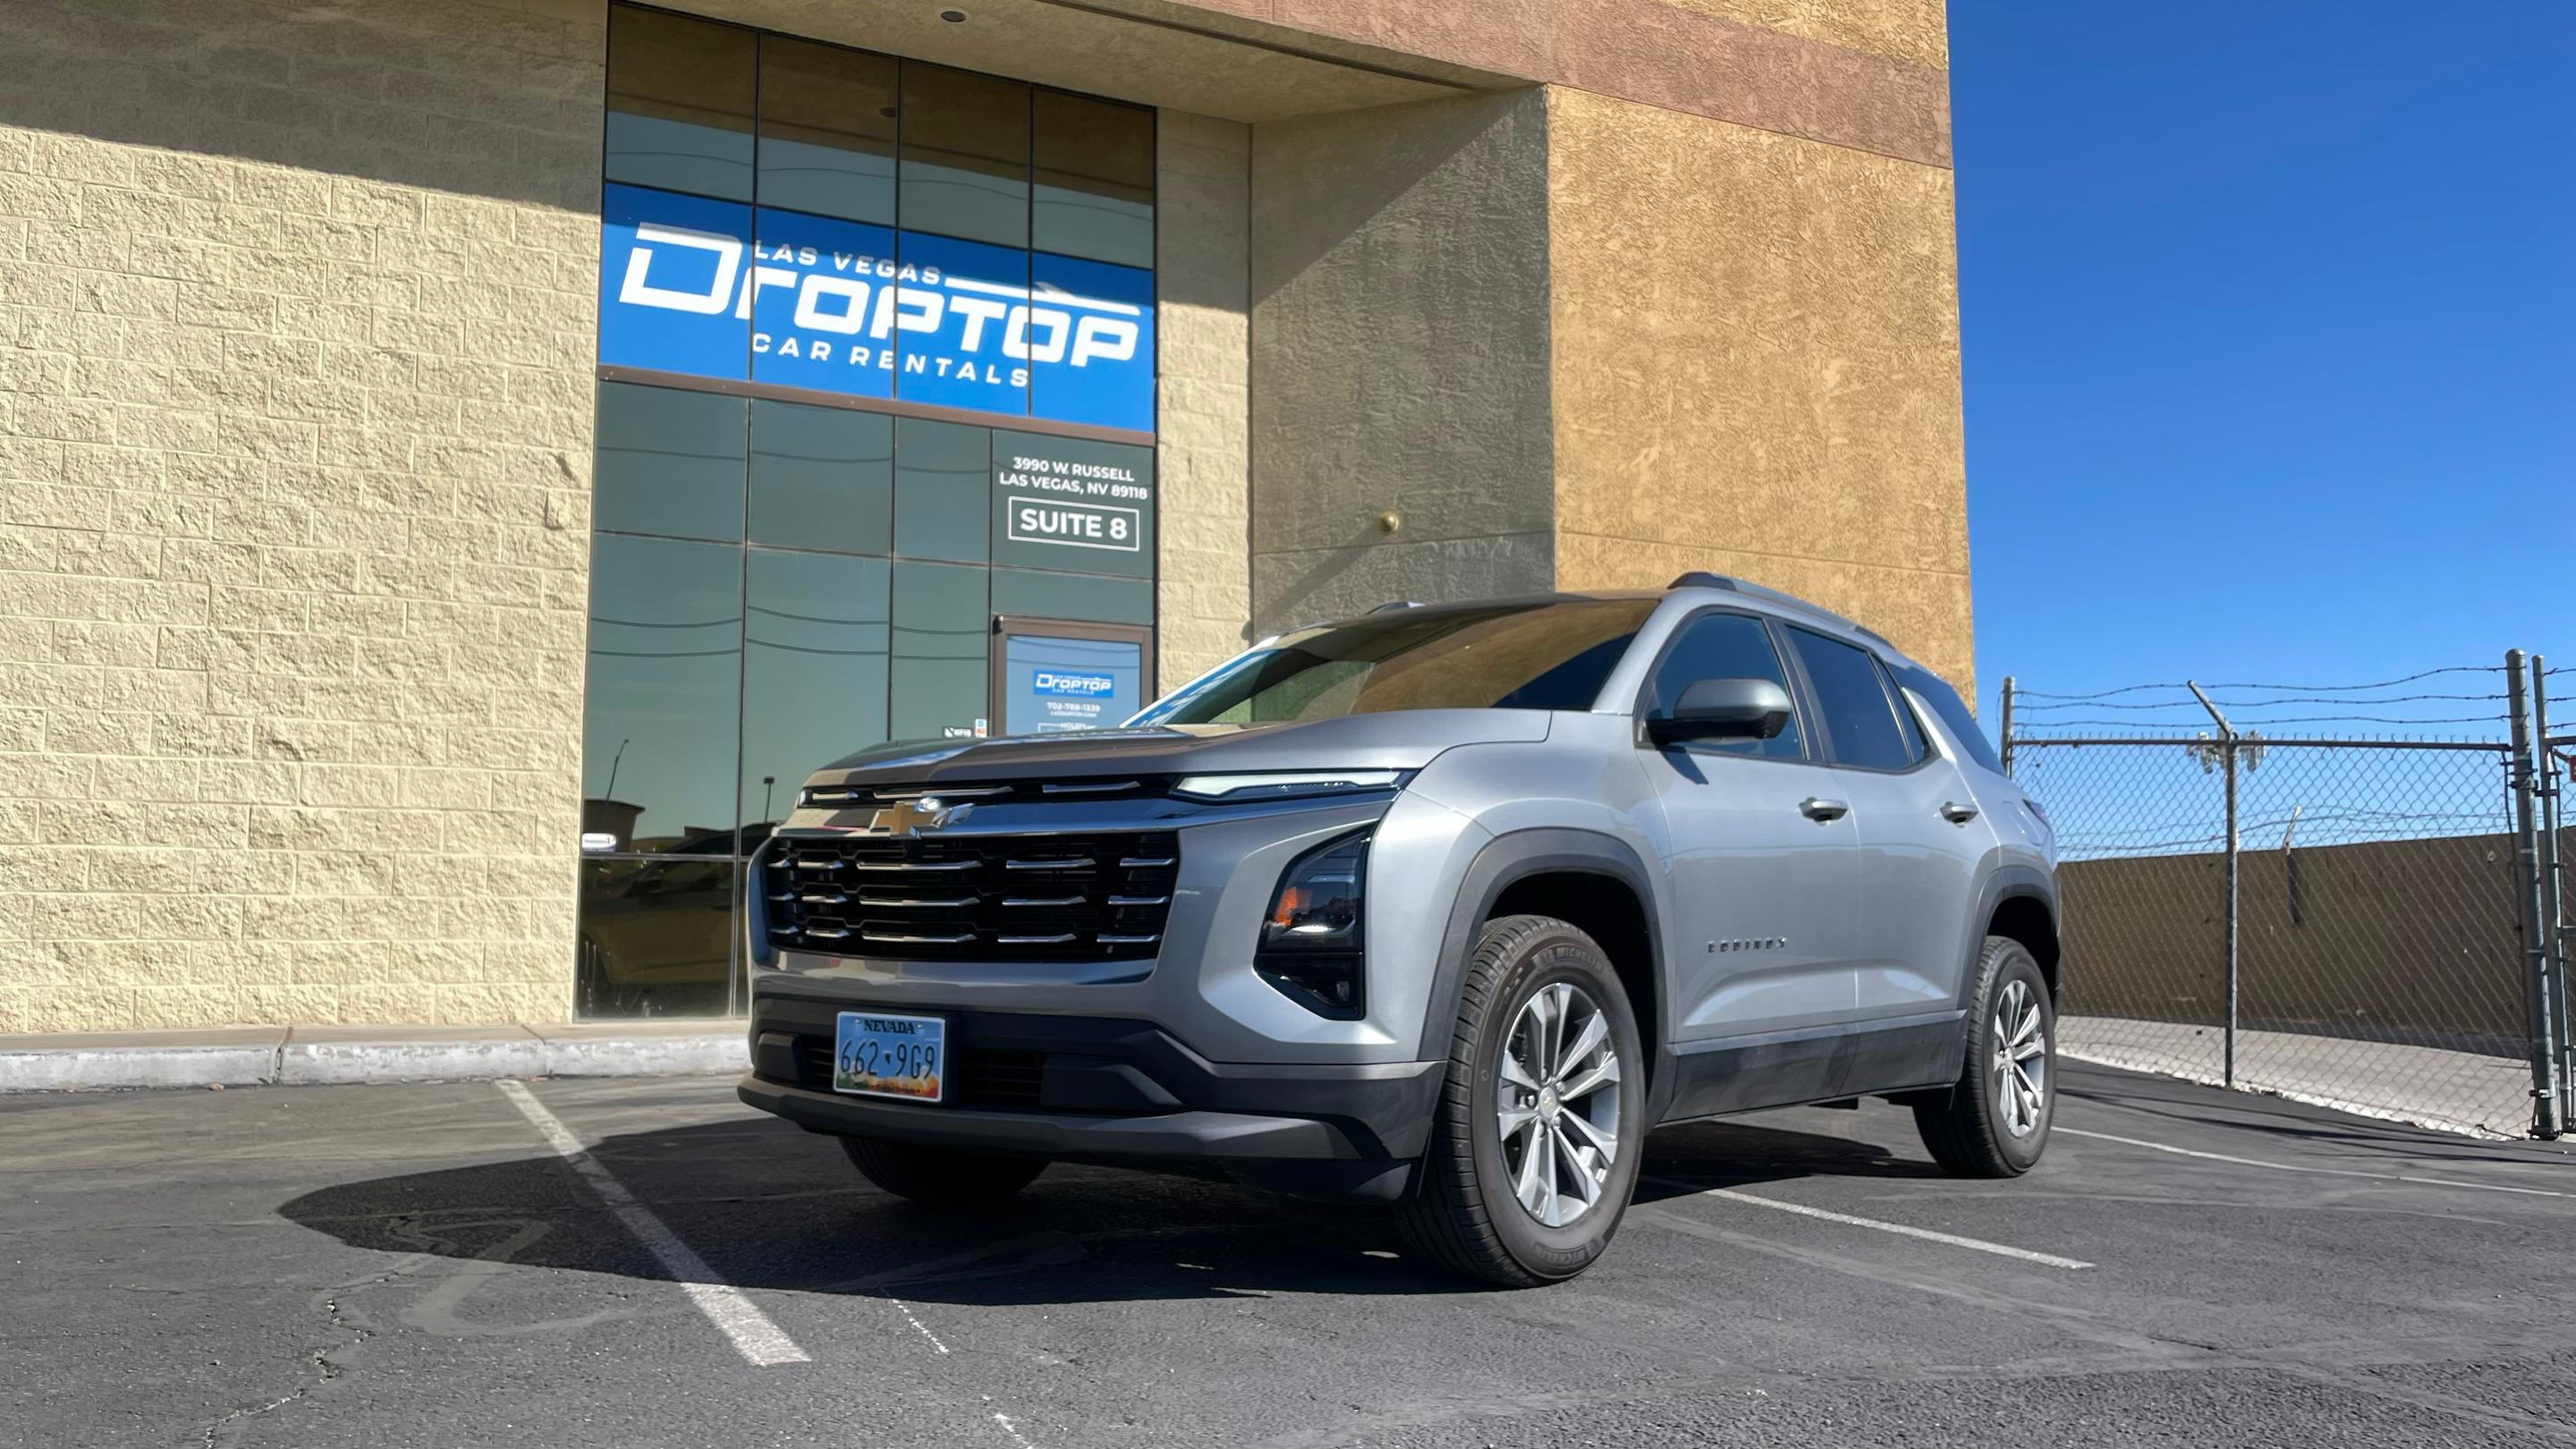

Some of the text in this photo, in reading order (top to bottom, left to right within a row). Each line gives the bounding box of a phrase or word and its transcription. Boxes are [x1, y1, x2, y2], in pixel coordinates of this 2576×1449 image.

[754, 240, 940, 285] LAS VEGAS
[752, 333, 1030, 388] CAR RENTALS
[1013, 456, 1049, 473] 3990
[1072, 463, 1135, 482] RUSSELL
[999, 471, 1148, 500] LAS VEGAS, NV 89118
[1020, 508, 1128, 540] SUITE 8
[863, 1019, 916, 1035] NEVADA
